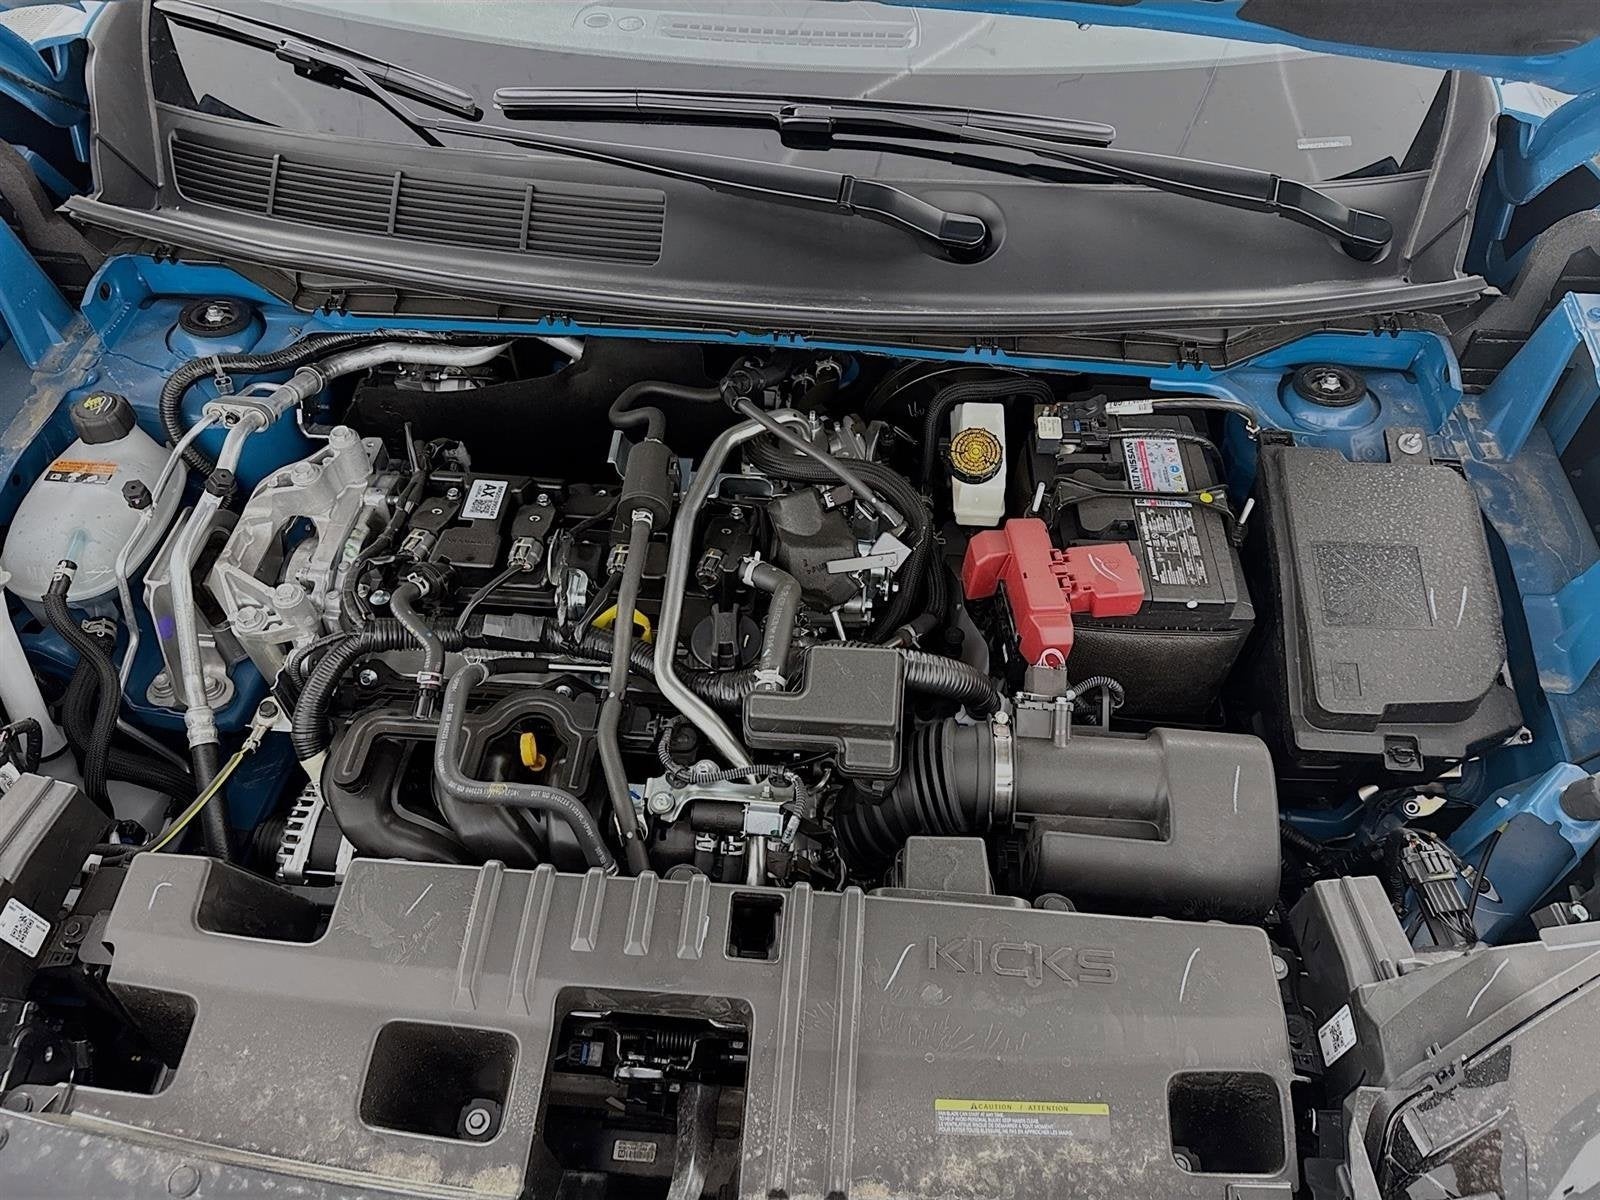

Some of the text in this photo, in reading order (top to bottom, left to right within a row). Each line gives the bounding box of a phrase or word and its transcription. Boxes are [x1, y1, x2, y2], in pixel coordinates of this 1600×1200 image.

[1126, 441, 1139, 473] NISSAN
[480, 483, 497, 499] AX
[928, 936, 1118, 985] KICKS
[1028, 1104, 1069, 1112] ATTENTION
